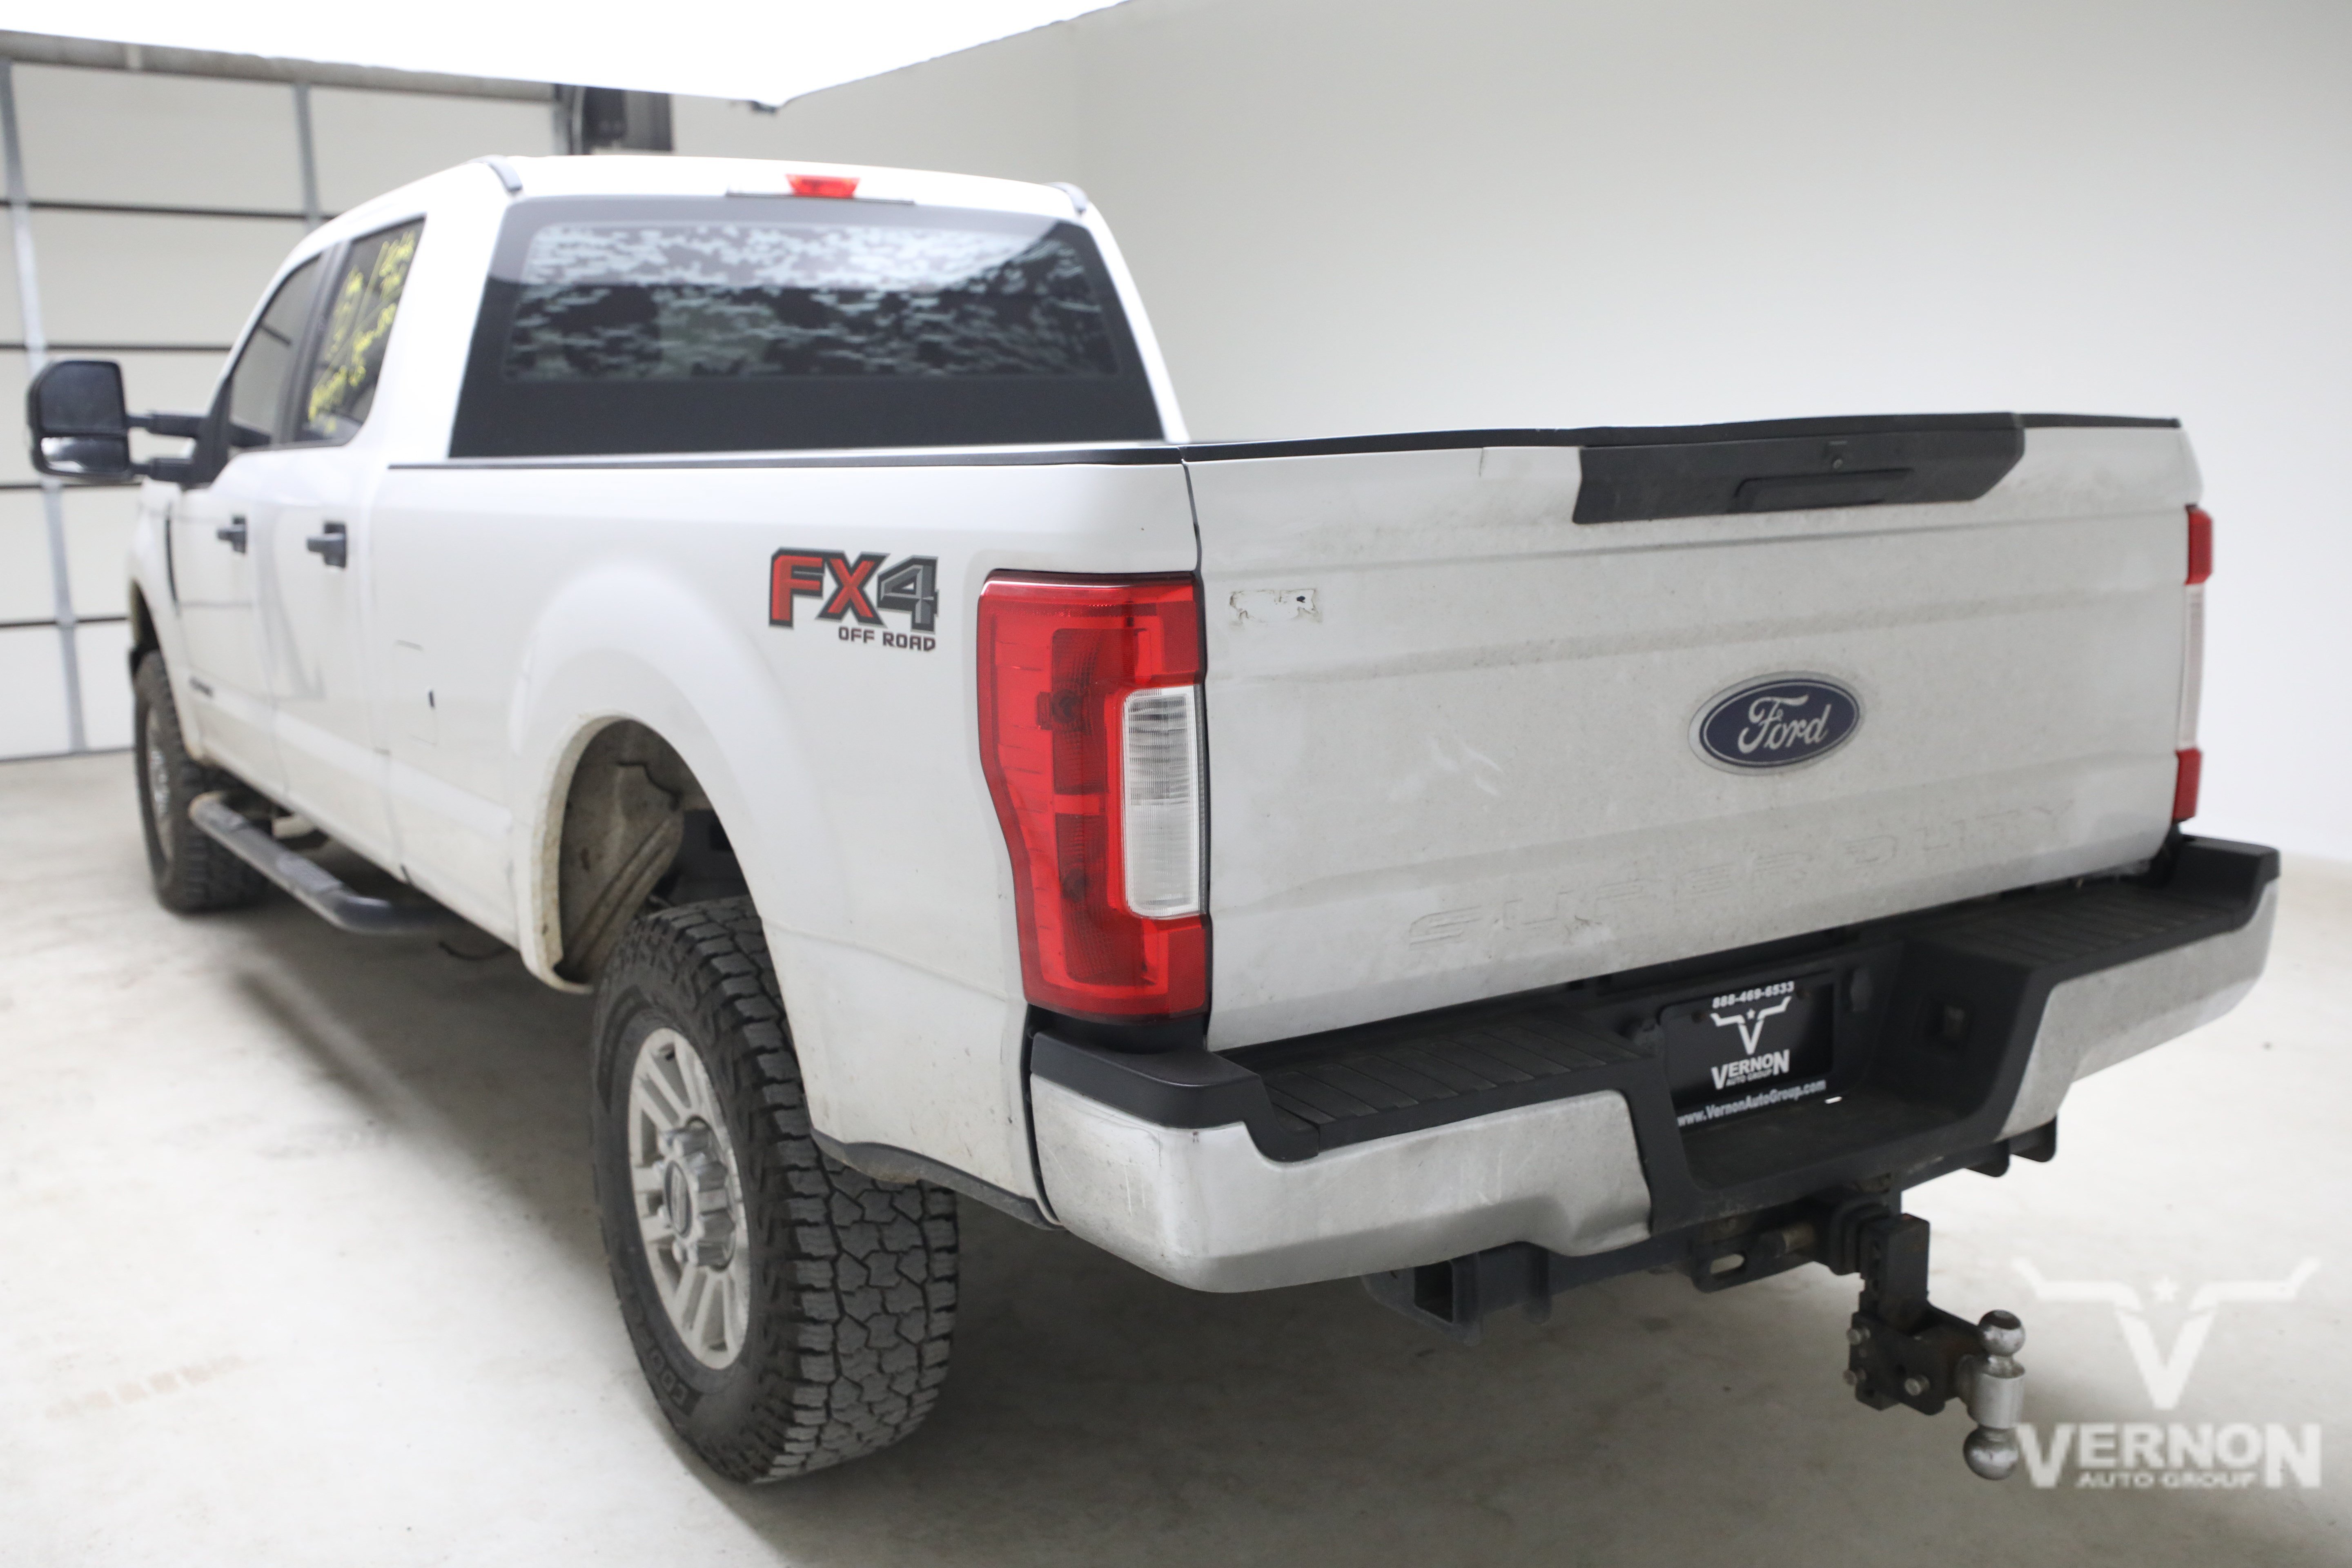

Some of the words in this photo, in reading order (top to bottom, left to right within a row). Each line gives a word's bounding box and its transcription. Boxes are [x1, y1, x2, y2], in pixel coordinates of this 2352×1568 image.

[768, 546, 939, 635] FX4
[838, 626, 875, 644] OFF
[882, 630, 936, 652] ROAD
[1738, 694, 1832, 754] Ford
[1711, 1049, 1790, 1090] VERNON
[1677, 1079, 1826, 1127] www.VernonAutoGroup.com
